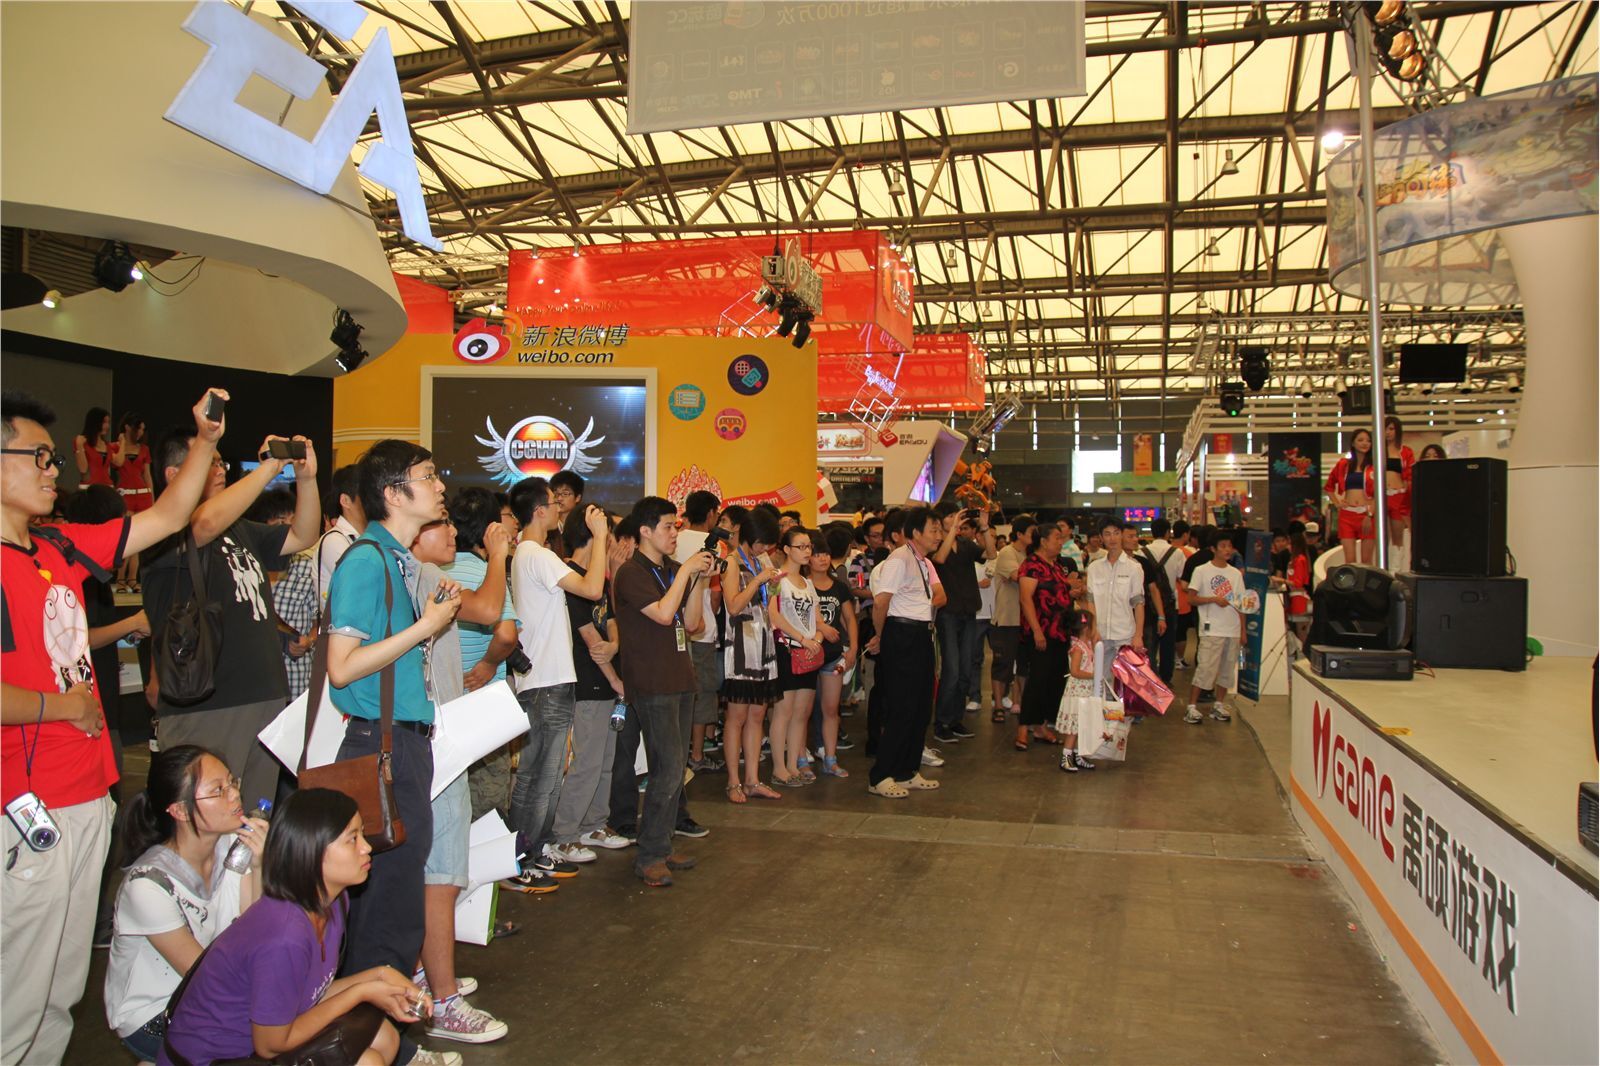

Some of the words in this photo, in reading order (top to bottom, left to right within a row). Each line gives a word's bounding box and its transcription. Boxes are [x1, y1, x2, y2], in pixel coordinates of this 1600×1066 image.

[523, 323, 630, 347] 新浪微博
[518, 350, 614, 364] weibo.com
[511, 440, 569, 459] CGWR
